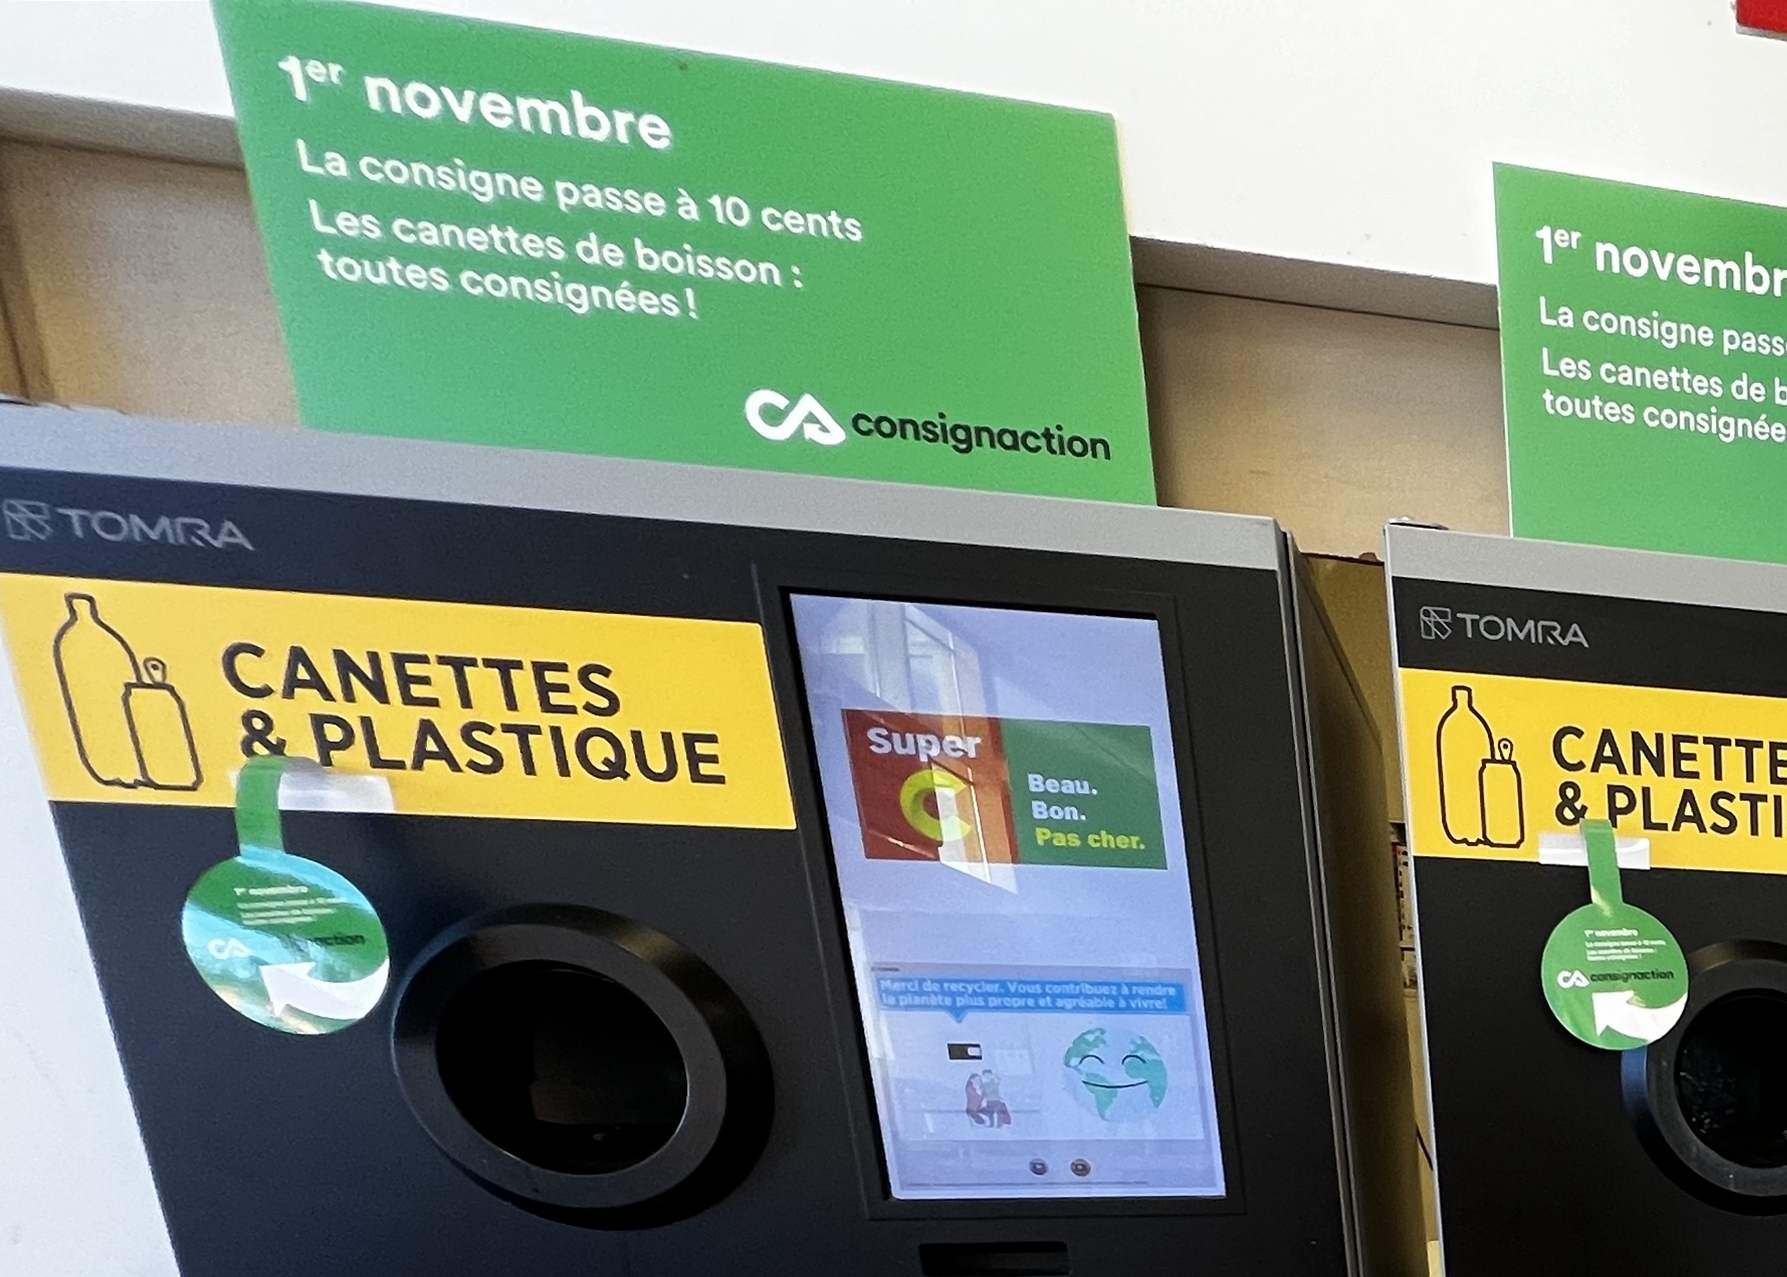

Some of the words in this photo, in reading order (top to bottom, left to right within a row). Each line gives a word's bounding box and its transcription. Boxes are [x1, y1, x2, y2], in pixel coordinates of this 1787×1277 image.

[280, 55, 344, 103] 1er
[366, 66, 674, 150] novembre
[295, 139, 349, 180] La
[359, 150, 544, 207] consigne
[555, 173, 667, 220] passe
[676, 186, 700, 222] à
[708, 194, 750, 228] 10
[761, 200, 864, 243] cents
[309, 199, 382, 241] Les
[391, 212, 566, 264] canettes
[575, 226, 625, 268] de
[634, 238, 782, 287] boisson
[1535, 225, 1581, 265] 1er
[316, 248, 451, 293] toutes
[1539, 296, 1574, 329] La
[1582, 304, 1715, 350] consigne
[1542, 348, 1592, 381] Les
[1599, 357, 1723, 399] canettes
[1731, 371, 1766, 402] de
[1542, 388, 1635, 426] toutes
[851, 410, 1112, 463] consignaction
[56, 507, 254, 550] TOMRA
[1457, 612, 1589, 648] TOMRA
[222, 642, 622, 717] CANETTES
[241, 709, 287, 758] &
[308, 713, 727, 785] PLASTIQUE
[866, 726, 986, 763] Super
[900, 767, 973, 842] C
[1027, 773, 1098, 796] Beau.
[1555, 780, 1588, 827] &
[1031, 800, 1087, 821] Bon.
[1035, 827, 1082, 848] Pas
[1087, 829, 1146, 850] cher.
[880, 979, 918, 991] Merci
[922, 979, 940, 992] de
[1008, 981, 1042, 994] Vous
[1045, 982, 1117, 995] contribuez
[1132, 984, 1176, 996] rendre
[1590, 968, 1675, 982] consignaction
[955, 995, 985, 1008] plus
[988, 996, 1035, 1009] propre
